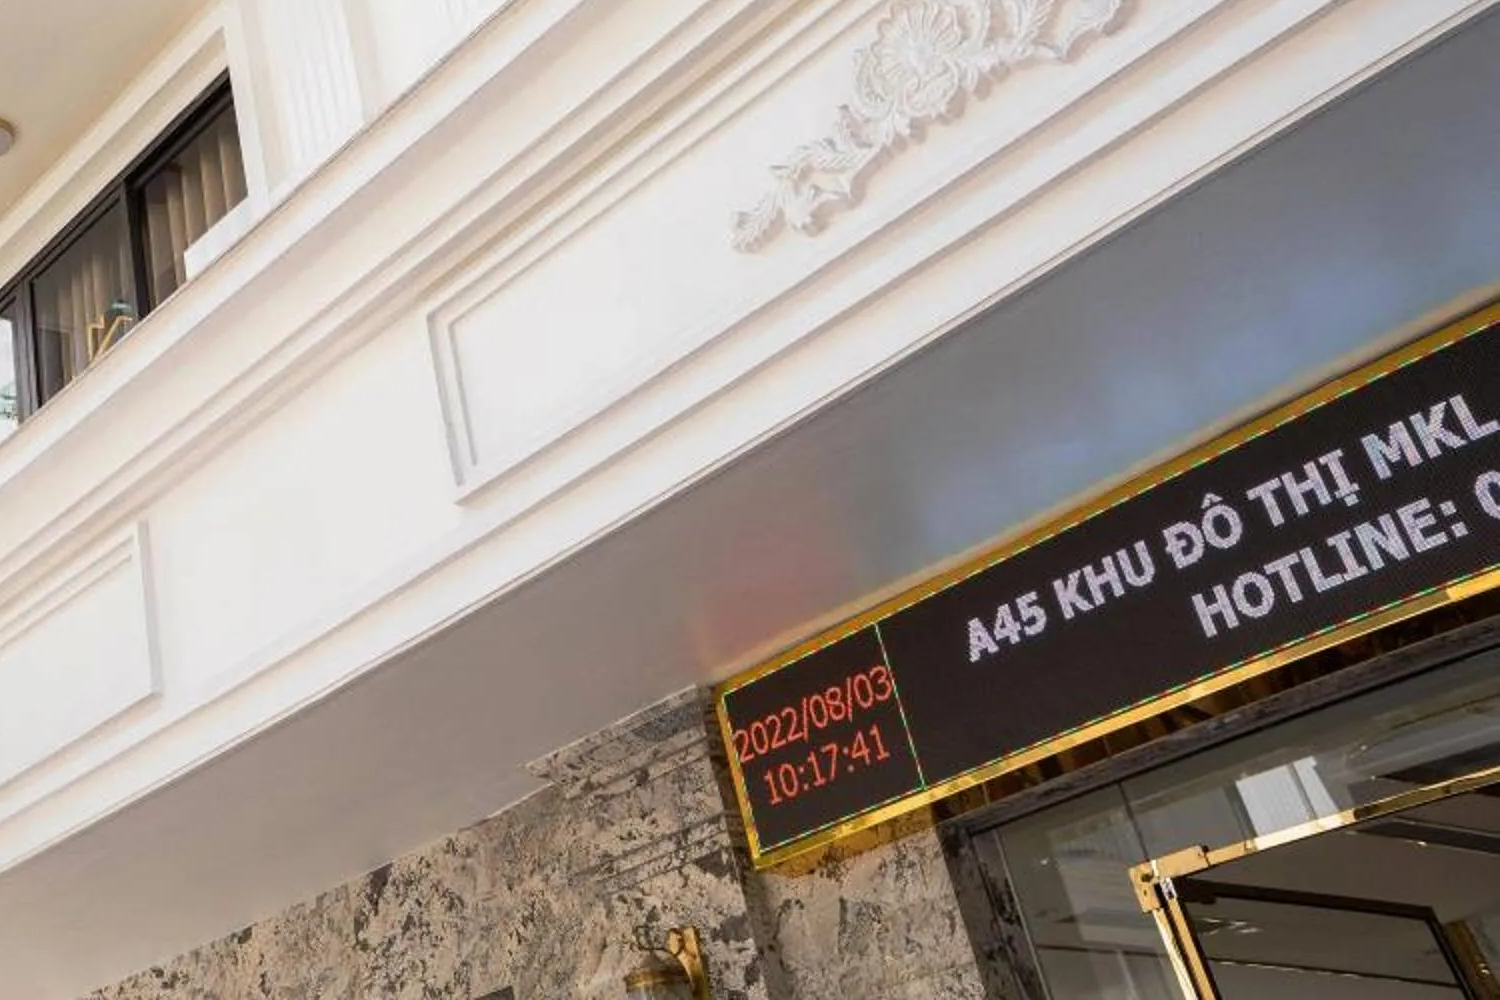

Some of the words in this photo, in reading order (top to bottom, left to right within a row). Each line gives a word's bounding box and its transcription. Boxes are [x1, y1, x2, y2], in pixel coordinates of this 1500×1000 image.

[967, 591, 1047, 663] A45
[1052, 540, 1156, 620] KHU
[1162, 493, 1243, 569] ĐÔ
[1246, 449, 1360, 527] THỊ
[1192, 497, 1469, 638] HOTLINE:
[731, 664, 894, 763] 2022/08/03
[764, 724, 891, 805] 10:17:41
